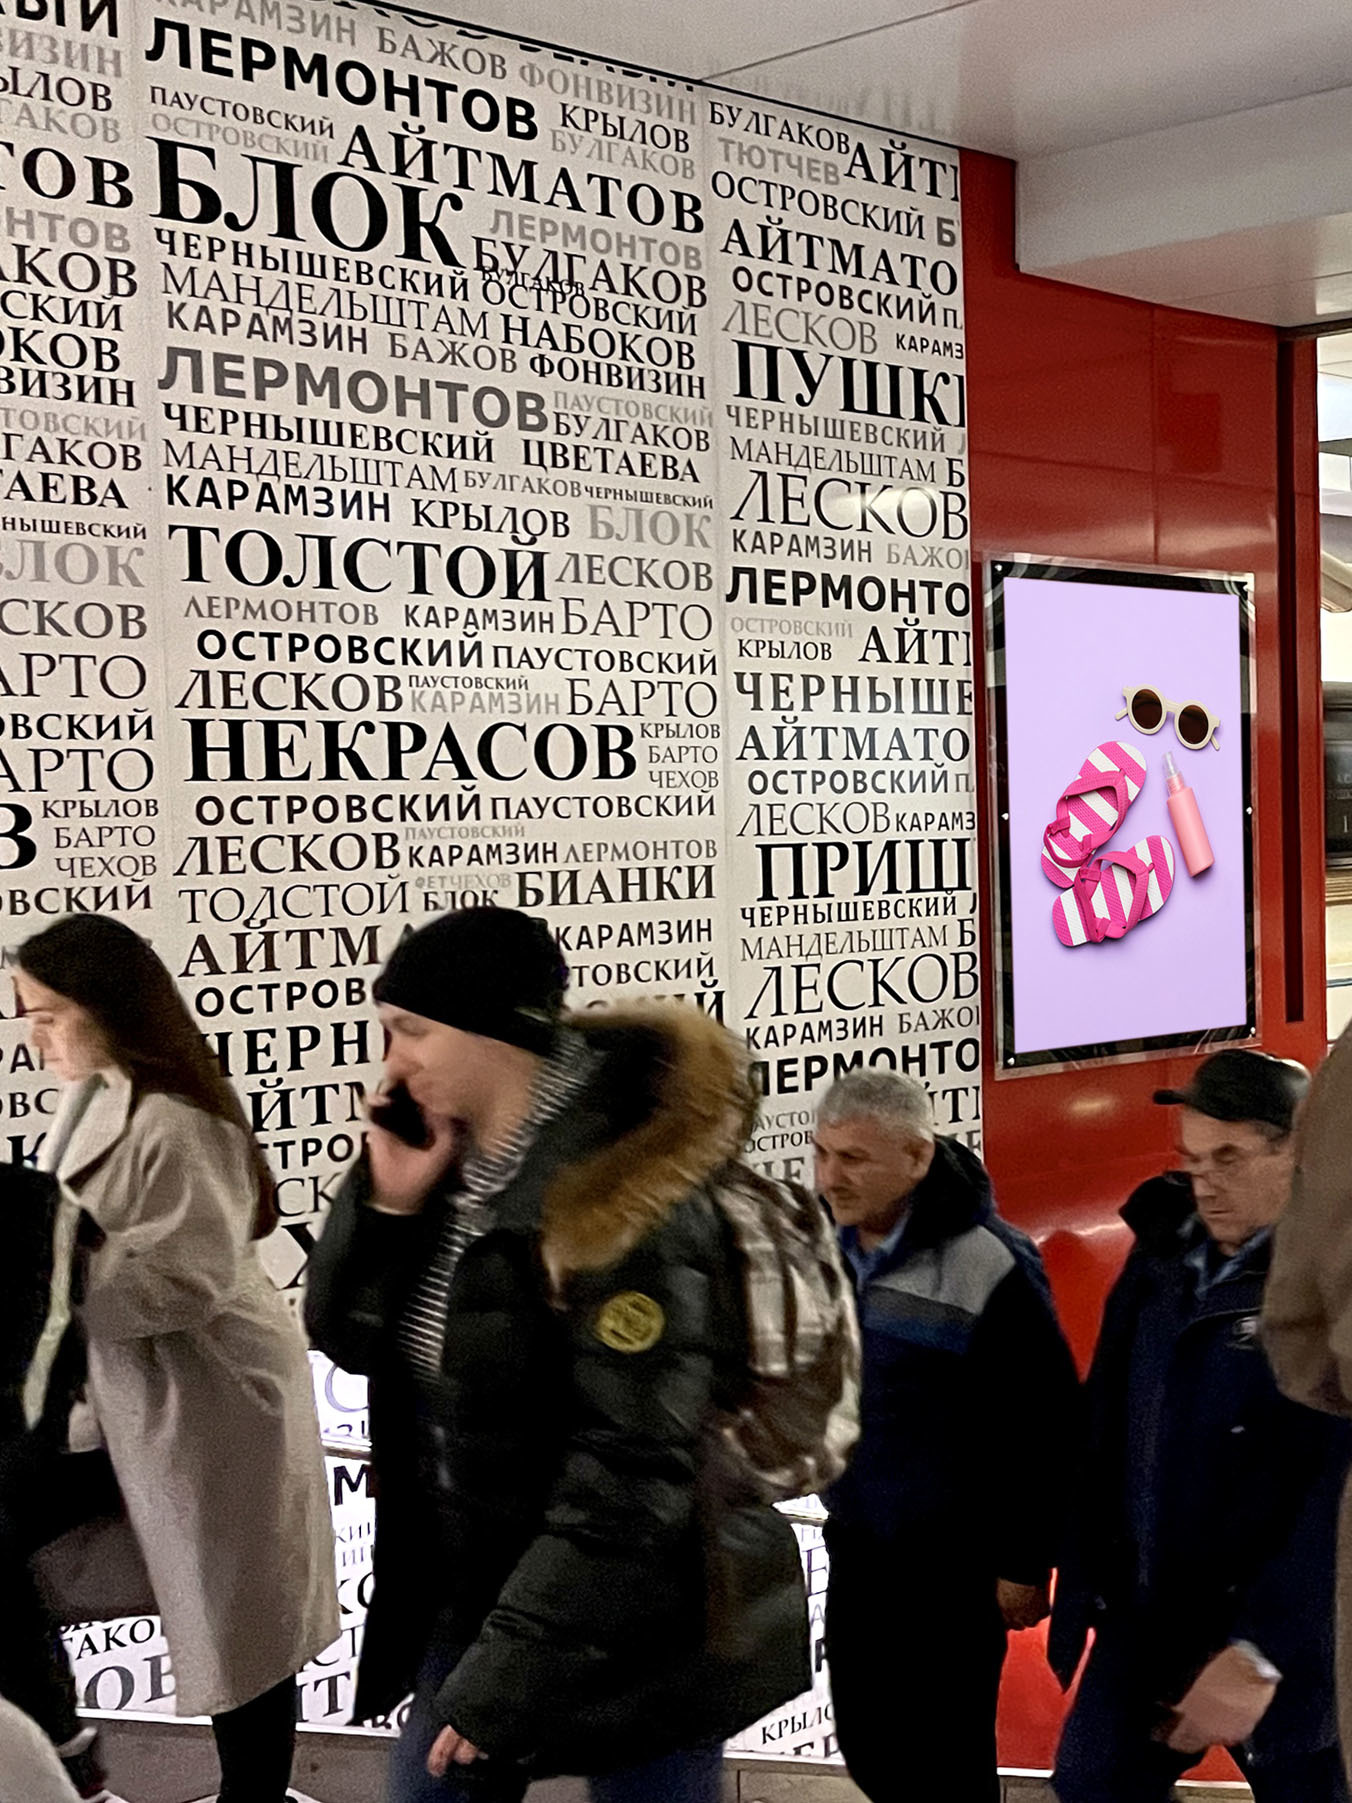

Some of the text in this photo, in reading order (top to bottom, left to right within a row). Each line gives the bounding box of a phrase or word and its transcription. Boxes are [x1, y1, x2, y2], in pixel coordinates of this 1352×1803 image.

[144, 17, 539, 142] ЛЕРМОНТОВ
[559, 101, 690, 154] КРЫЛОВ
[376, 26, 508, 80] БАЖОВ
[518, 61, 697, 126] ФОНВИЗИН
[150, 85, 335, 140] ПАУСТОВСКИЙ
[151, 112, 329, 164] ОСТРОВСКИЙ
[708, 100, 850, 155] БУЛГАКОВ
[336, 121, 705, 234] АЙТМАТОВ БУЛГАКОВ
[717, 137, 841, 186] ТЮТЧЕВ
[144, 135, 468, 269] БЛОК
[710, 170, 926, 240] ОСТРОВСКИЙ
[489, 208, 703, 271] ЛЕРМОНТОВ
[719, 214, 958, 296] АЙТМАТО
[153, 226, 469, 302] ЧЕРНЫШЕВСКИЙ
[481, 277, 698, 337] ОСТРОВСКИЙ
[470, 235, 708, 309] БУЛГАКОВ
[731, 265, 937, 326] ОСТРОВСКИЙ
[160, 261, 489, 341] МАНДЕЛЬШТАМ
[500, 312, 696, 372] НАБОКОВ
[721, 299, 879, 355] ЛЕСКОВ
[166, 299, 368, 356] КАРАМЗИН
[389, 330, 519, 375] БАЖОВ
[529, 352, 706, 401] ФОНВИЗИН
[156, 345, 549, 433] ЛЕРМОНТОВ
[552, 389, 714, 428] ПАУСТОВСКИЙ
[161, 401, 701, 485] ЧЕРНЫШЕВСКИЙ ЦВЕТАЕВА
[551, 410, 711, 453] БУЛГАКОВ
[725, 403, 946, 453] ЧЕРНЫШЕВСКИЙ
[161, 437, 715, 511] МАНДЕЛЬШТАМ БУЛГАКОВ ЧЕРНЫШЕВСКИЙ
[729, 435, 936, 483] МАНДЕЛЬШТАМ
[165, 472, 713, 549] КАРАМЗИН КРЫЛОВ БЛОК
[730, 469, 969, 541] ЛЕСКОВ
[167, 523, 715, 603] ТОЛСТОЙ ЛЕСКОВ
[732, 528, 969, 570] КАРАМЗИН БАЖО
[725, 565, 970, 618] ЛЕРМОНТО
[183, 595, 714, 642] ЛЕРМОНТОВ КАРАМЗИН БАРТО
[730, 616, 854, 639] ОСТРОВСКИЙ
[737, 616, 971, 667] КРЫЛОВ АЙТ
[196, 628, 719, 677] ОСТРОВСКИЙ ПАУСТОВСКИЙ
[174, 668, 404, 714] ЛЕСКОВ
[564, 676, 719, 719] БАРТО
[408, 674, 530, 691] ПАУСТОВСКИЙ
[410, 689, 561, 716] КАРАМЗИН
[180, 718, 638, 784] НЕКРАСОВ
[639, 721, 722, 740] КРЫЛОВ
[647, 744, 719, 765] БАРТО
[735, 715, 971, 762] АЙТМАТО
[648, 769, 720, 790] ЧЕХОВ
[747, 761, 949, 796] ОСТРОВСКИЙ
[41, 797, 159, 822] КРЫЛОВ
[194, 783, 717, 827] ОСТРОВСКИЙ ПАУСТОВСКИЙ
[736, 801, 892, 837] ЛЕСКОВ
[54, 824, 156, 849] БАРТО
[172, 831, 401, 877] ЛЕСКОВ
[407, 838, 719, 869] КАРАМЗИН ЛЕРМОНТОВ
[55, 854, 157, 881] ЧЕХОВ
[755, 837, 973, 902] ПРИШ
[177, 863, 718, 925] ТОЛСТОЙ БИАНКИ
[740, 889, 958, 929] ЧЕРНЫШЕВСКИЙ
[177, 917, 413, 978] АЙТМ
[554, 917, 714, 952] КАРАМЗИН
[740, 924, 949, 962] МАНДЕЛЬШТАМ
[743, 950, 979, 1020] ЛЕСКОВ
[746, 1005, 980, 1051] КАРАМЗИН БАЖО
